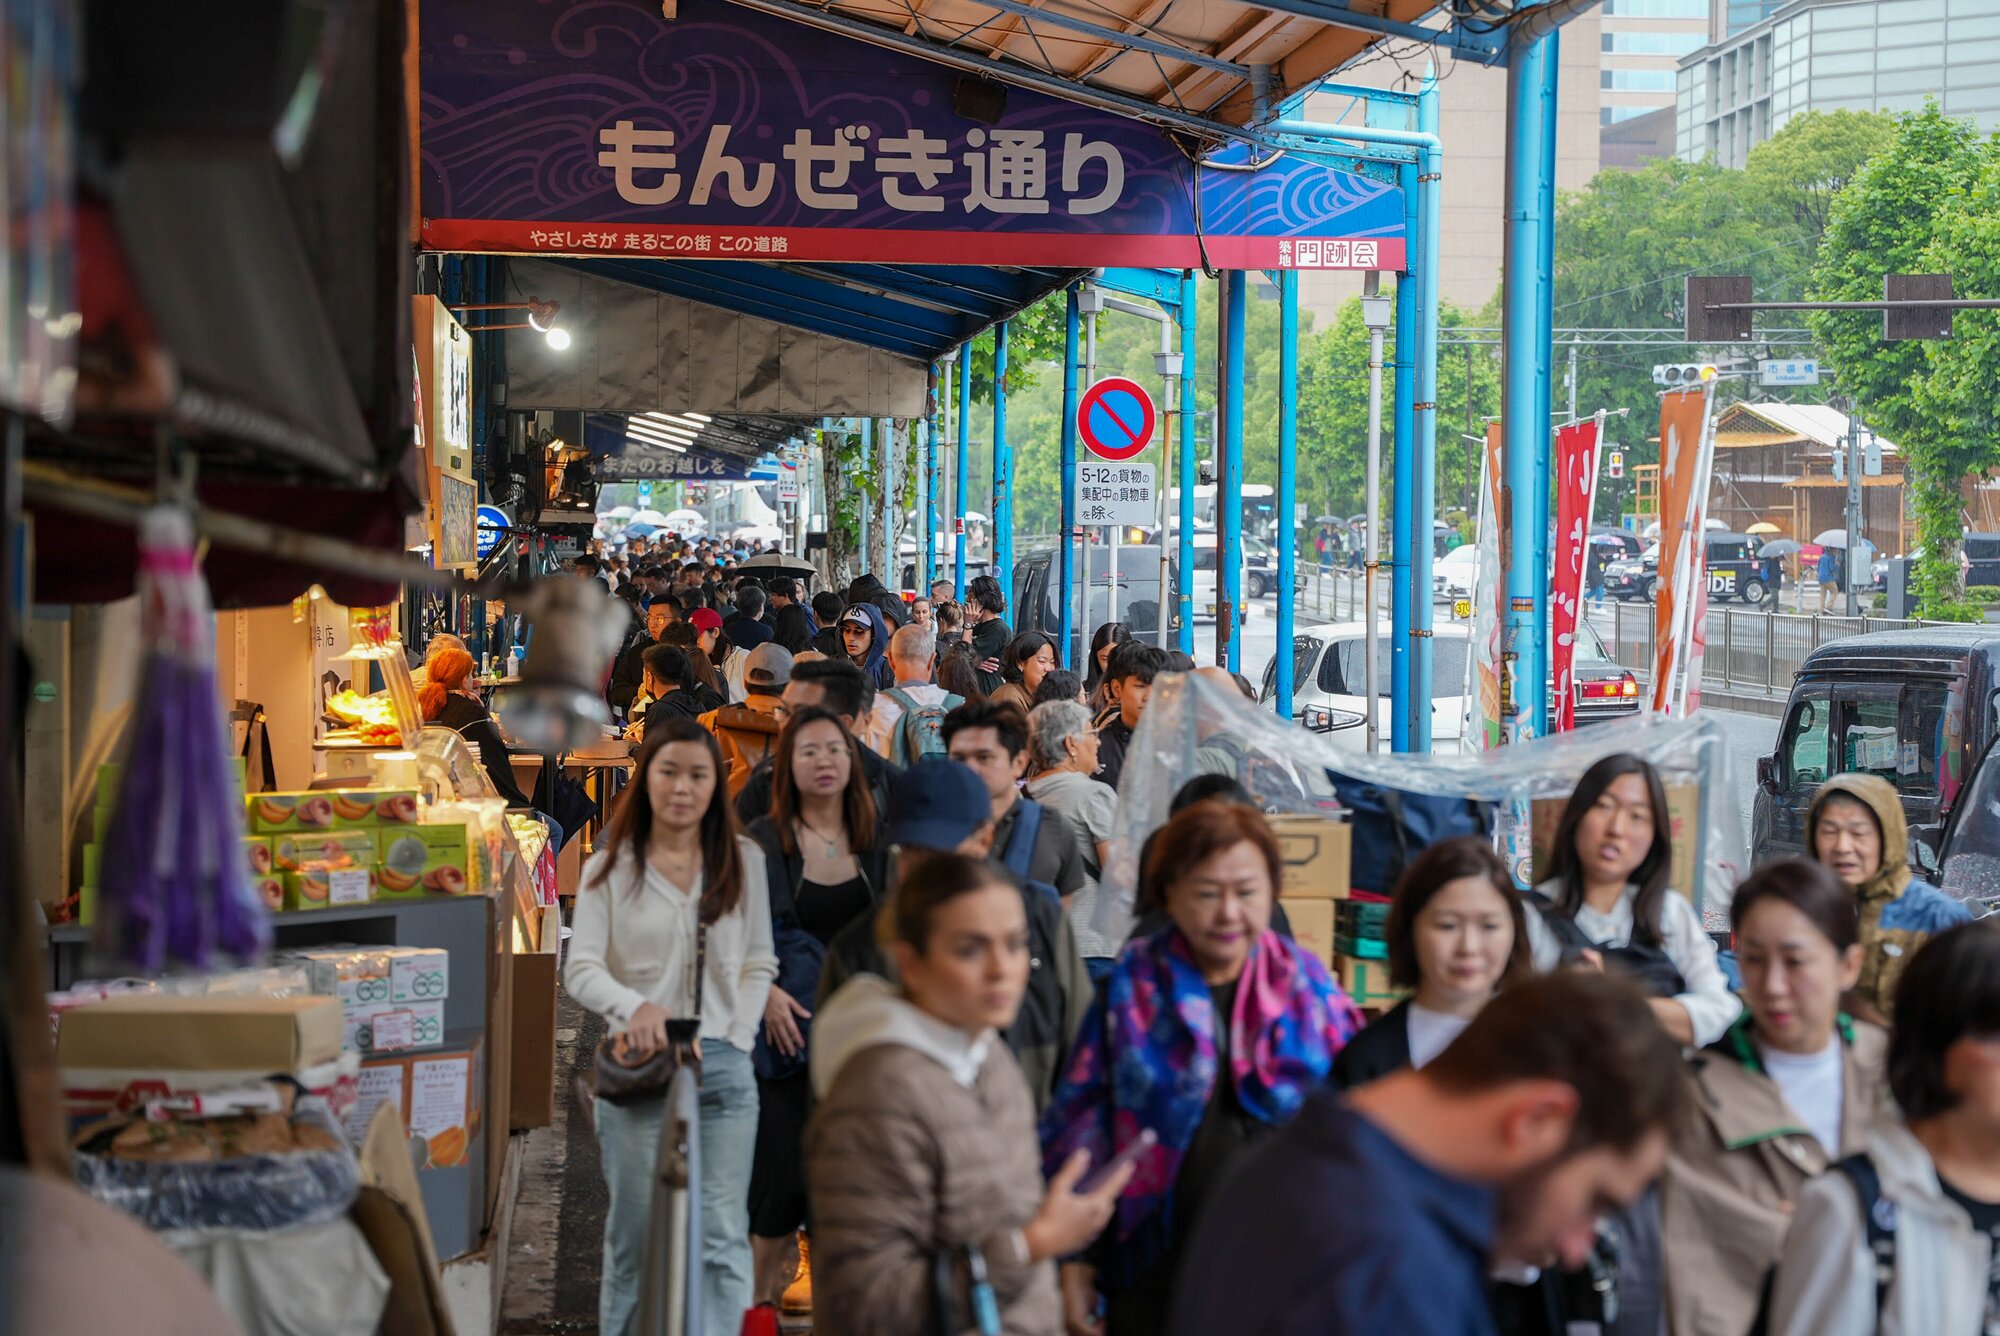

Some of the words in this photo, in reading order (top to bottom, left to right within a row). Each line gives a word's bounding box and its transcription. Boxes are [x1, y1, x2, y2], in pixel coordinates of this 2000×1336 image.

[598, 120, 1125, 215] もんぜき通り
[529, 230, 618, 249] やさしさが
[719, 235, 788, 253] この道路
[1297, 241, 1377, 267] 門跡会
[603, 457, 726, 475] またのお越しを
[1081, 468, 1149, 484] 5-12の貨物の
[1081, 487, 1149, 502] 集配中の貨物車
[1081, 505, 1115, 520] を除く
